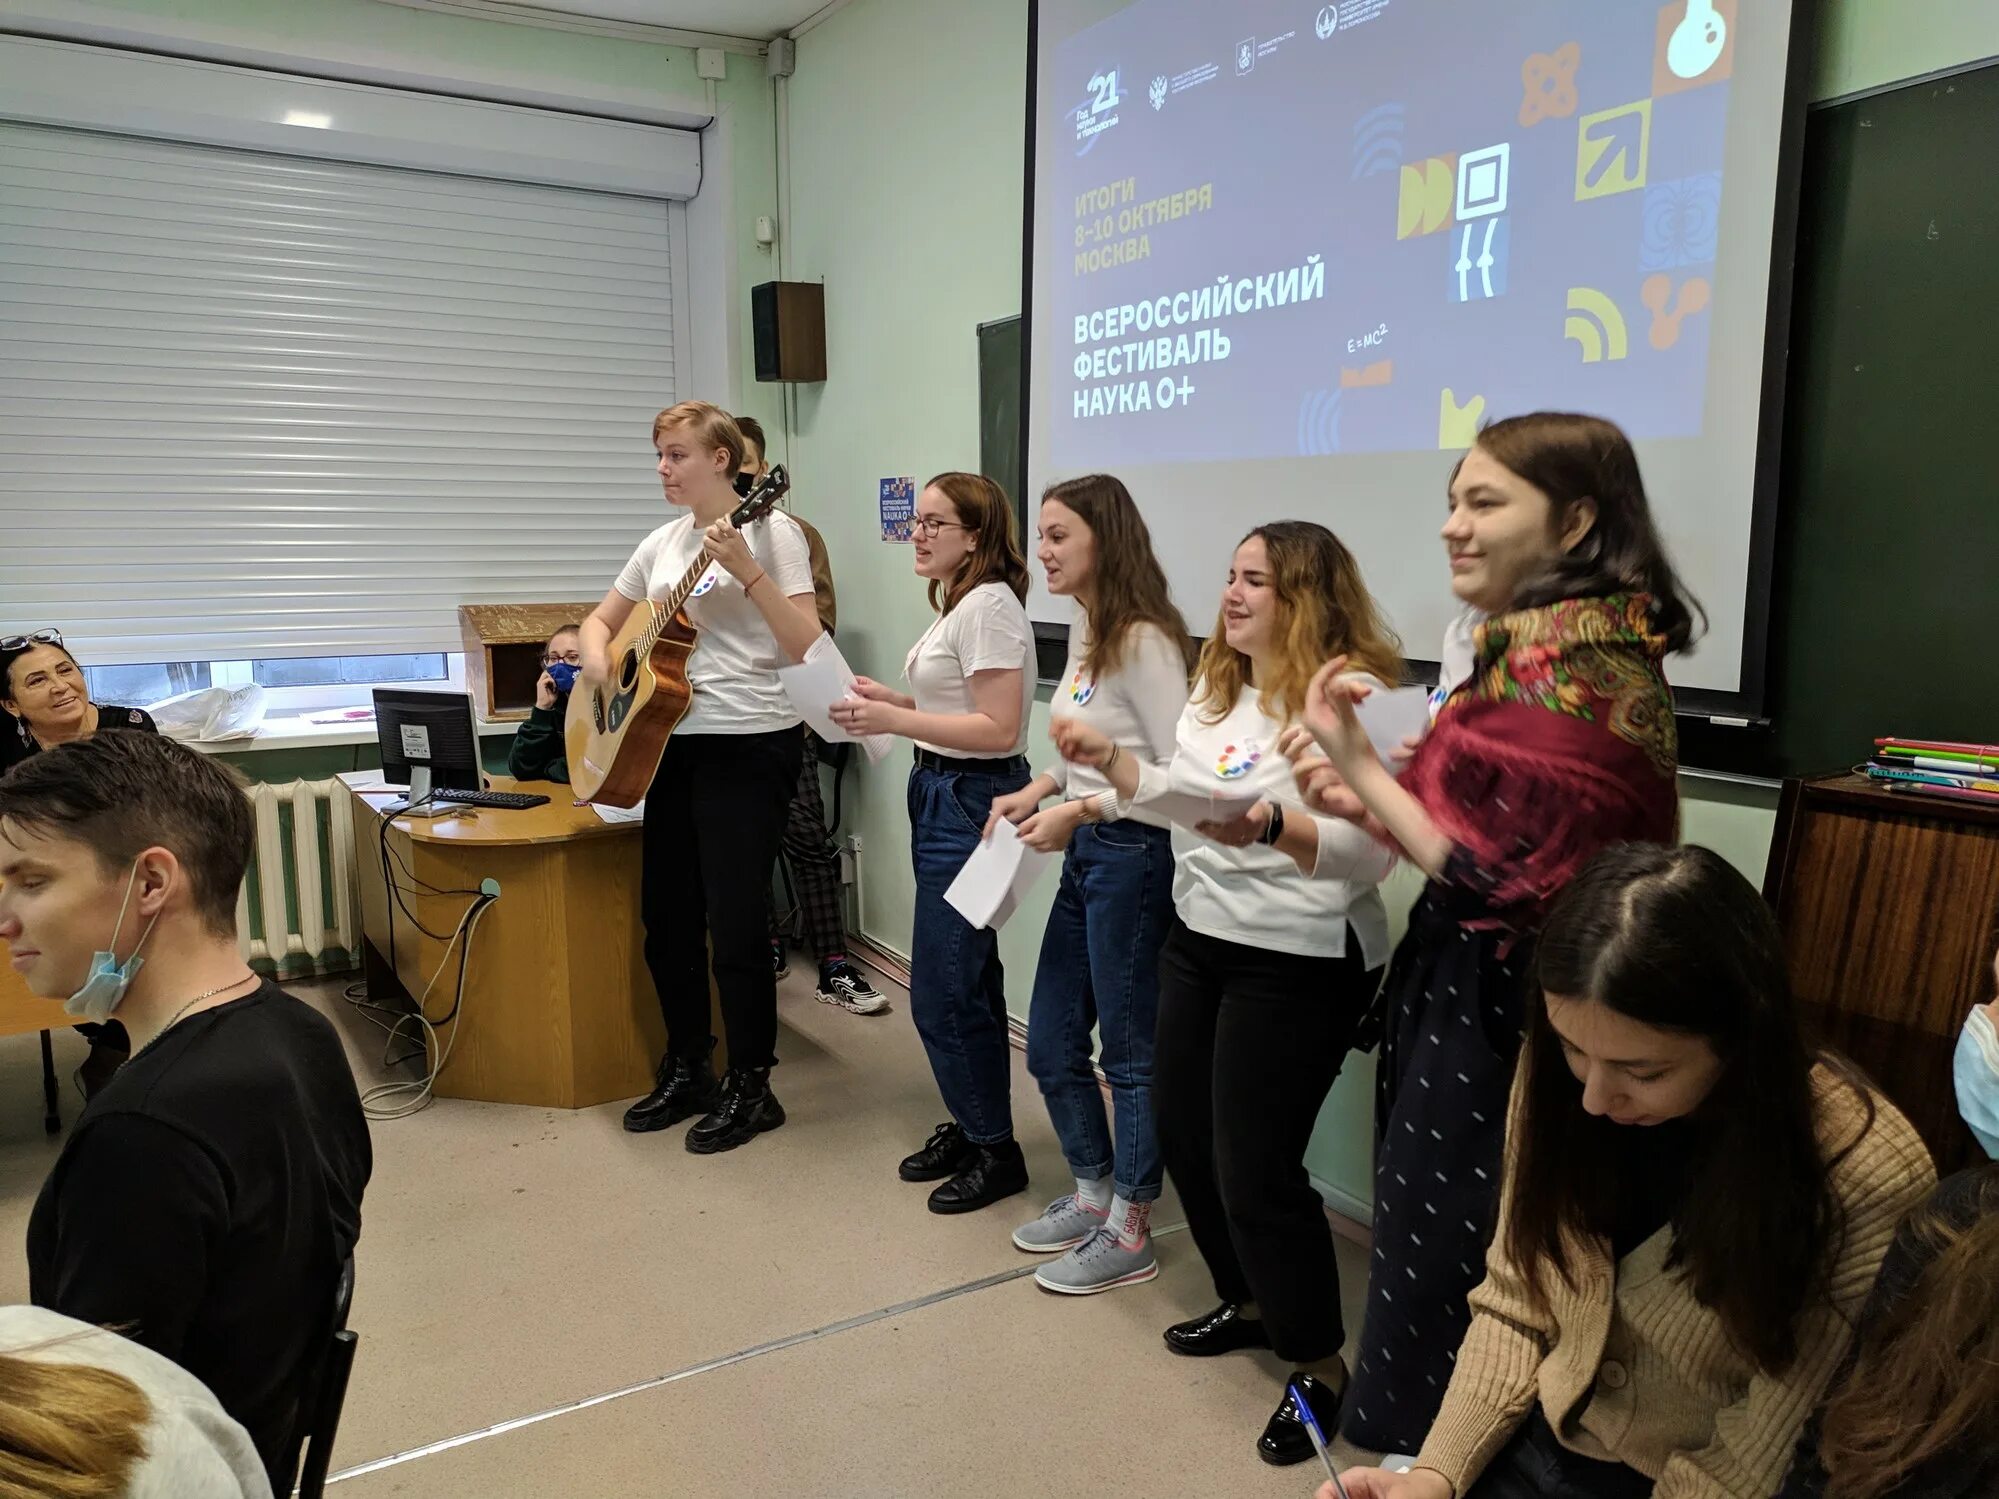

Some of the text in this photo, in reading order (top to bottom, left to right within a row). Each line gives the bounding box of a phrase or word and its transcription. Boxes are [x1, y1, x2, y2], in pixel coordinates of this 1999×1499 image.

[1074, 176, 1136, 219] ИТОГИ
[1118, 182, 1213, 235] ОКТЯБРЯ
[1074, 234, 1152, 278] МОСКВА
[1073, 253, 1325, 345] ВСЕРОССИЙСКИЙ
[1073, 327, 1232, 381] ФЕСТИВАЛЬ
[1073, 381, 1152, 419] НАУКА
